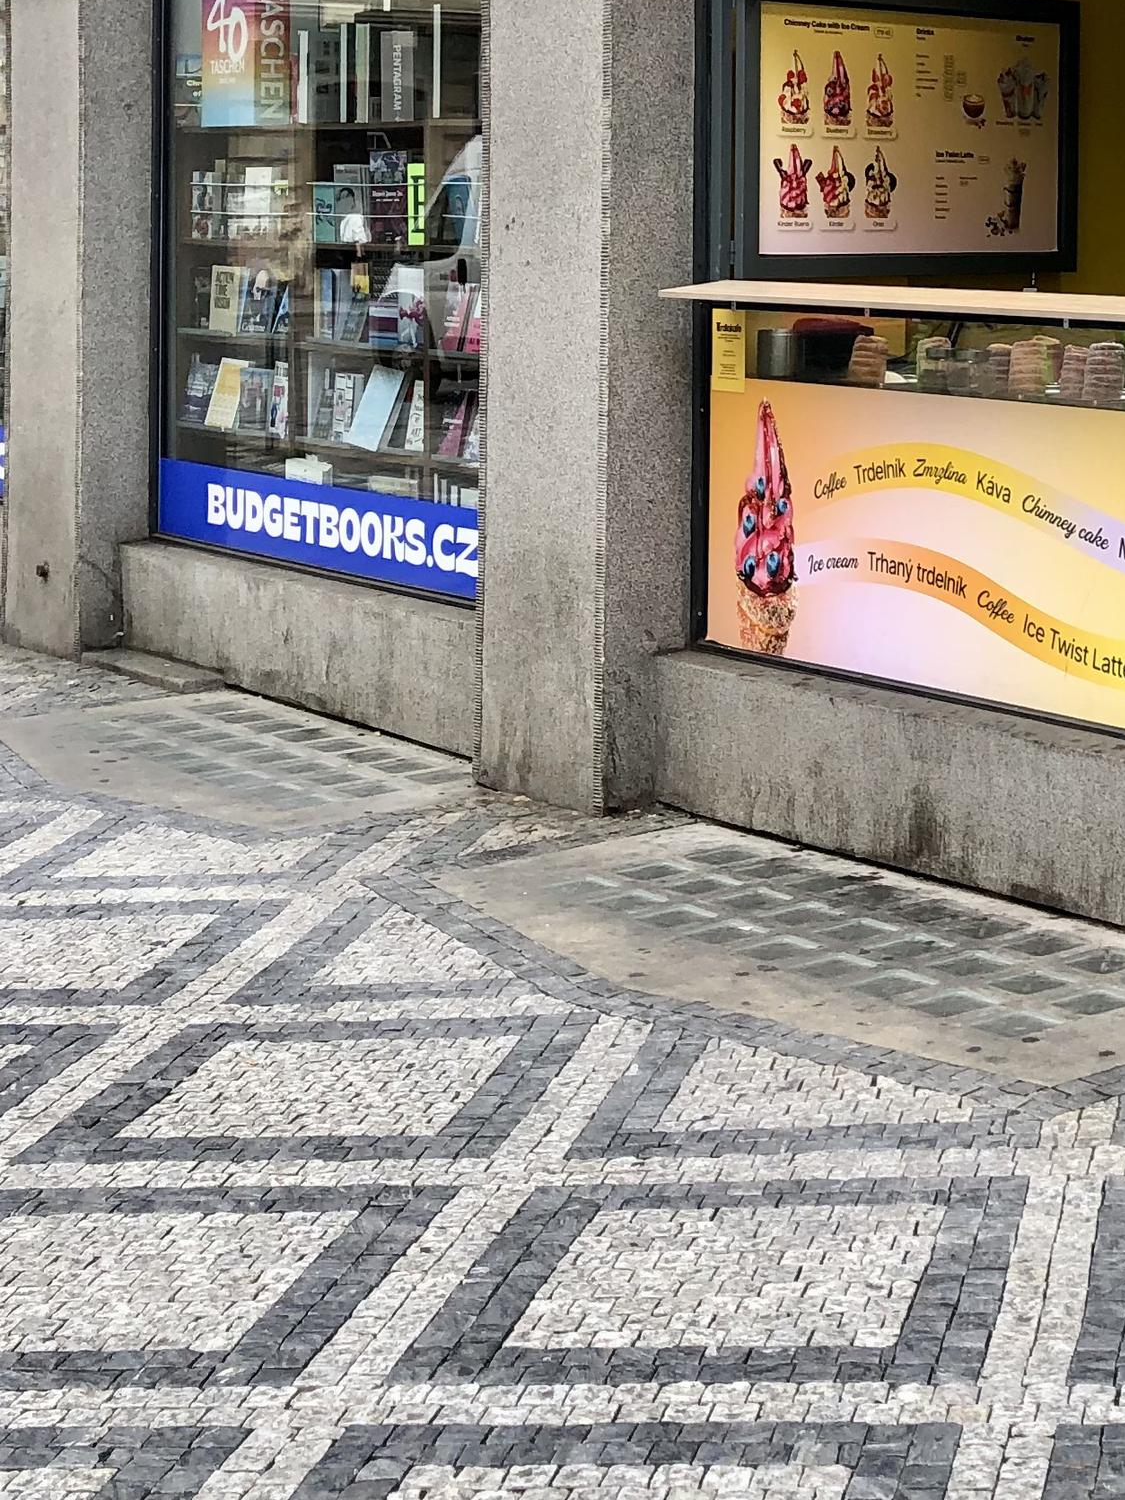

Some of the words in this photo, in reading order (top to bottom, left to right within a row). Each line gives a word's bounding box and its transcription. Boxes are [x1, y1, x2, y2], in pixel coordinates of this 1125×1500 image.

[784, 19, 811, 29] Chimney
[210, 58, 245, 75] TASCHEN
[392, 44, 402, 111] PENTAGRAM
[206, 483, 479, 578] BUDGETBOOKS.CZ
[814, 472, 847, 499] Coffee
[853, 457, 907, 485] Trdelník
[913, 458, 968, 485] Zmrzlina
[976, 471, 1012, 504] Káva
[1022, 494, 1076, 539] Chimney
[1078, 528, 1110, 551] cake
[808, 554, 824, 575] Ice
[826, 555, 859, 570] cream
[868, 551, 913, 583] Trhaný
[916, 563, 968, 599] trdelník
[977, 590, 1015, 624] Coffee
[1023, 614, 1045, 643] Ice
[1050, 628, 1089, 666] Twist
